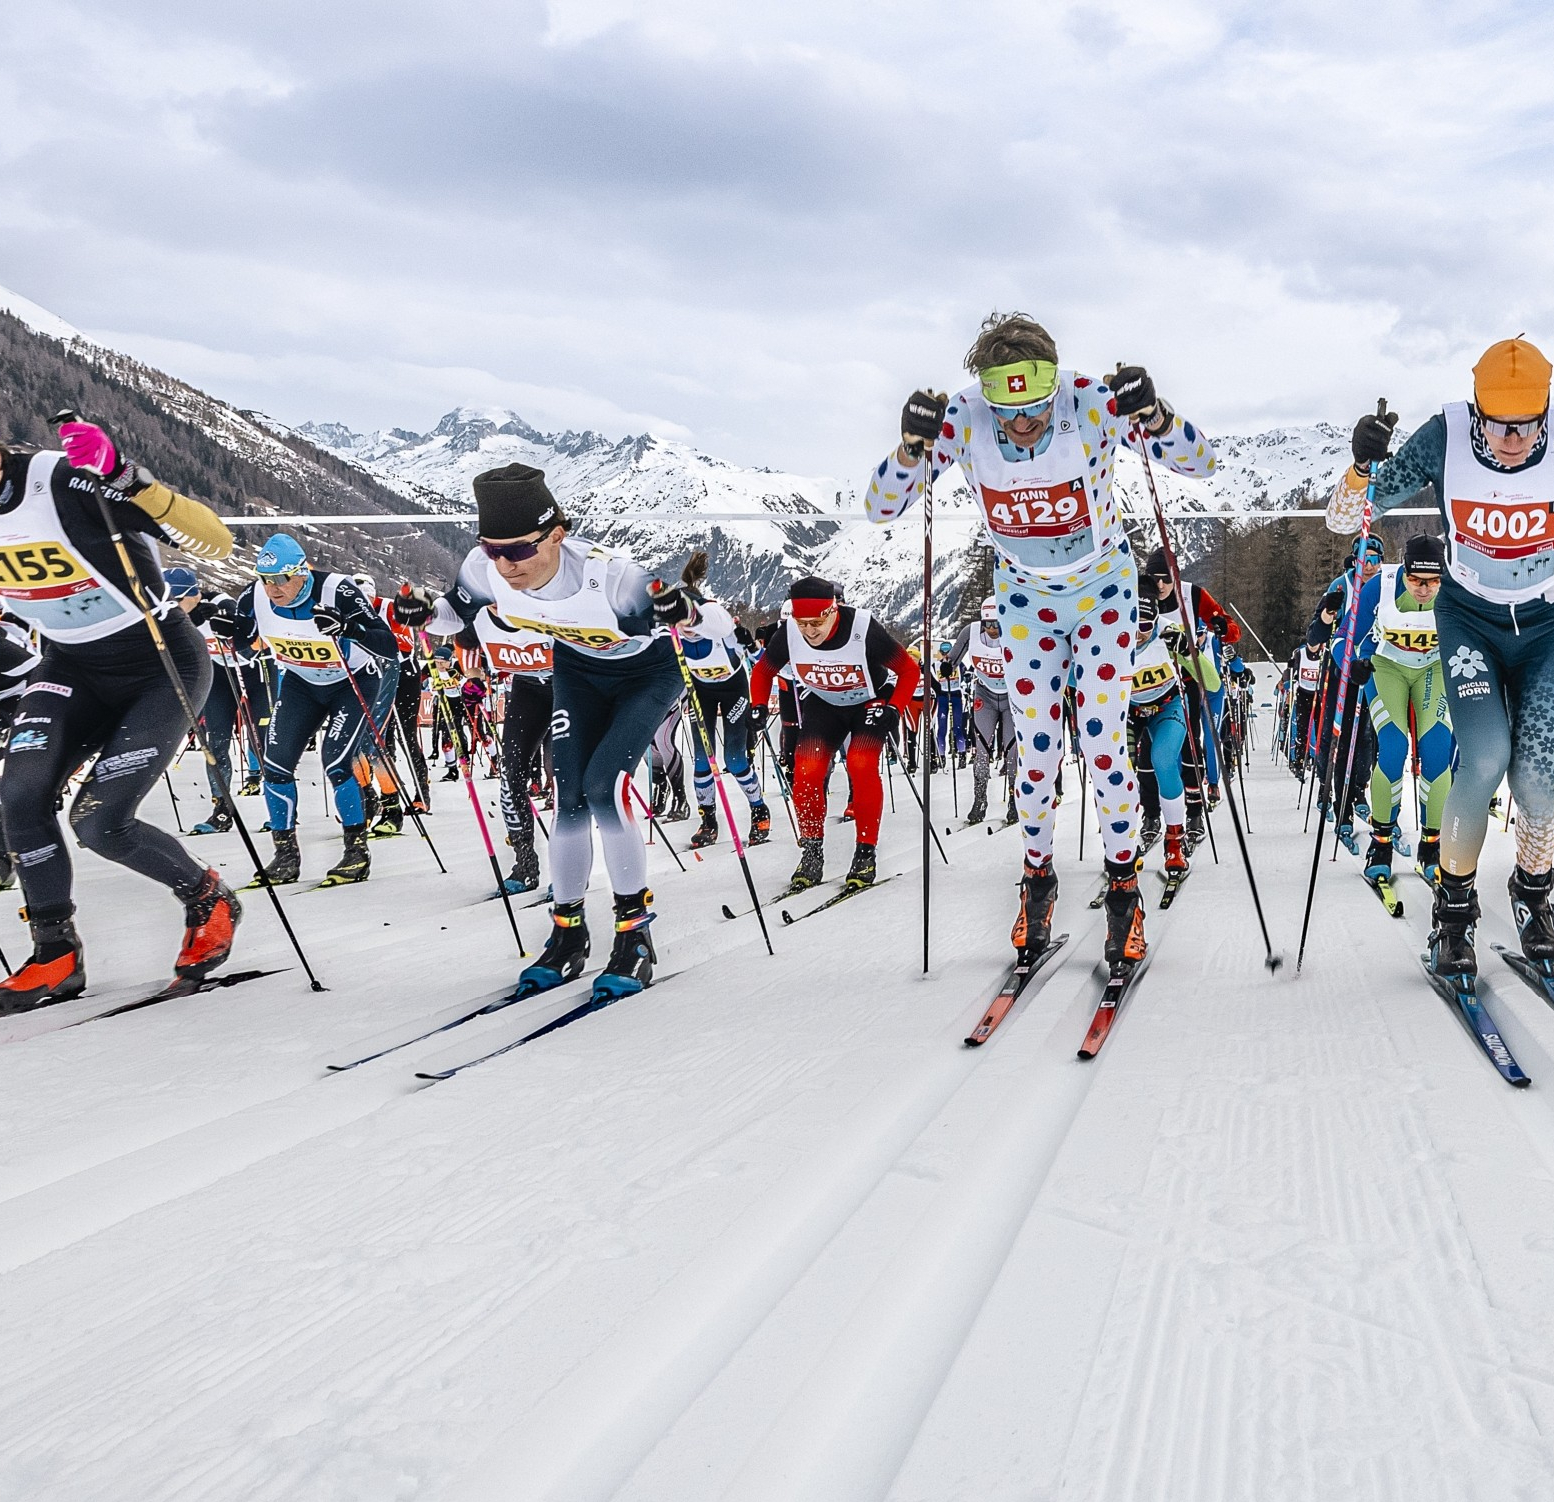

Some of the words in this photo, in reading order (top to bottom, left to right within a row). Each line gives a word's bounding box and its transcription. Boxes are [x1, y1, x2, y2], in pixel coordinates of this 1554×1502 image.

[68, 476, 131, 502] RAIFEIS
[1073, 481, 1081, 491] A
[922, 452, 933, 543] SWIX
[1010, 490, 1049, 502] YANN
[991, 496, 1079, 525] 4129
[1466, 507, 1548, 540] 4002
[0, 547, 75, 582] 155
[1385, 631, 1440, 648] 2145
[275, 643, 332, 661] 2019
[498, 647, 547, 666] 4004
[812, 665, 847, 673] MARKUS
[1303, 671, 1319, 679] 421
[804, 671, 860, 686] 4104
[1132, 668, 1167, 689] 141
[1457, 682, 1490, 691] SKICLUB
[1458, 687, 1491, 698] HORW
[726, 696, 745, 719] SKICLUB
[328, 709, 350, 742] SWIX
